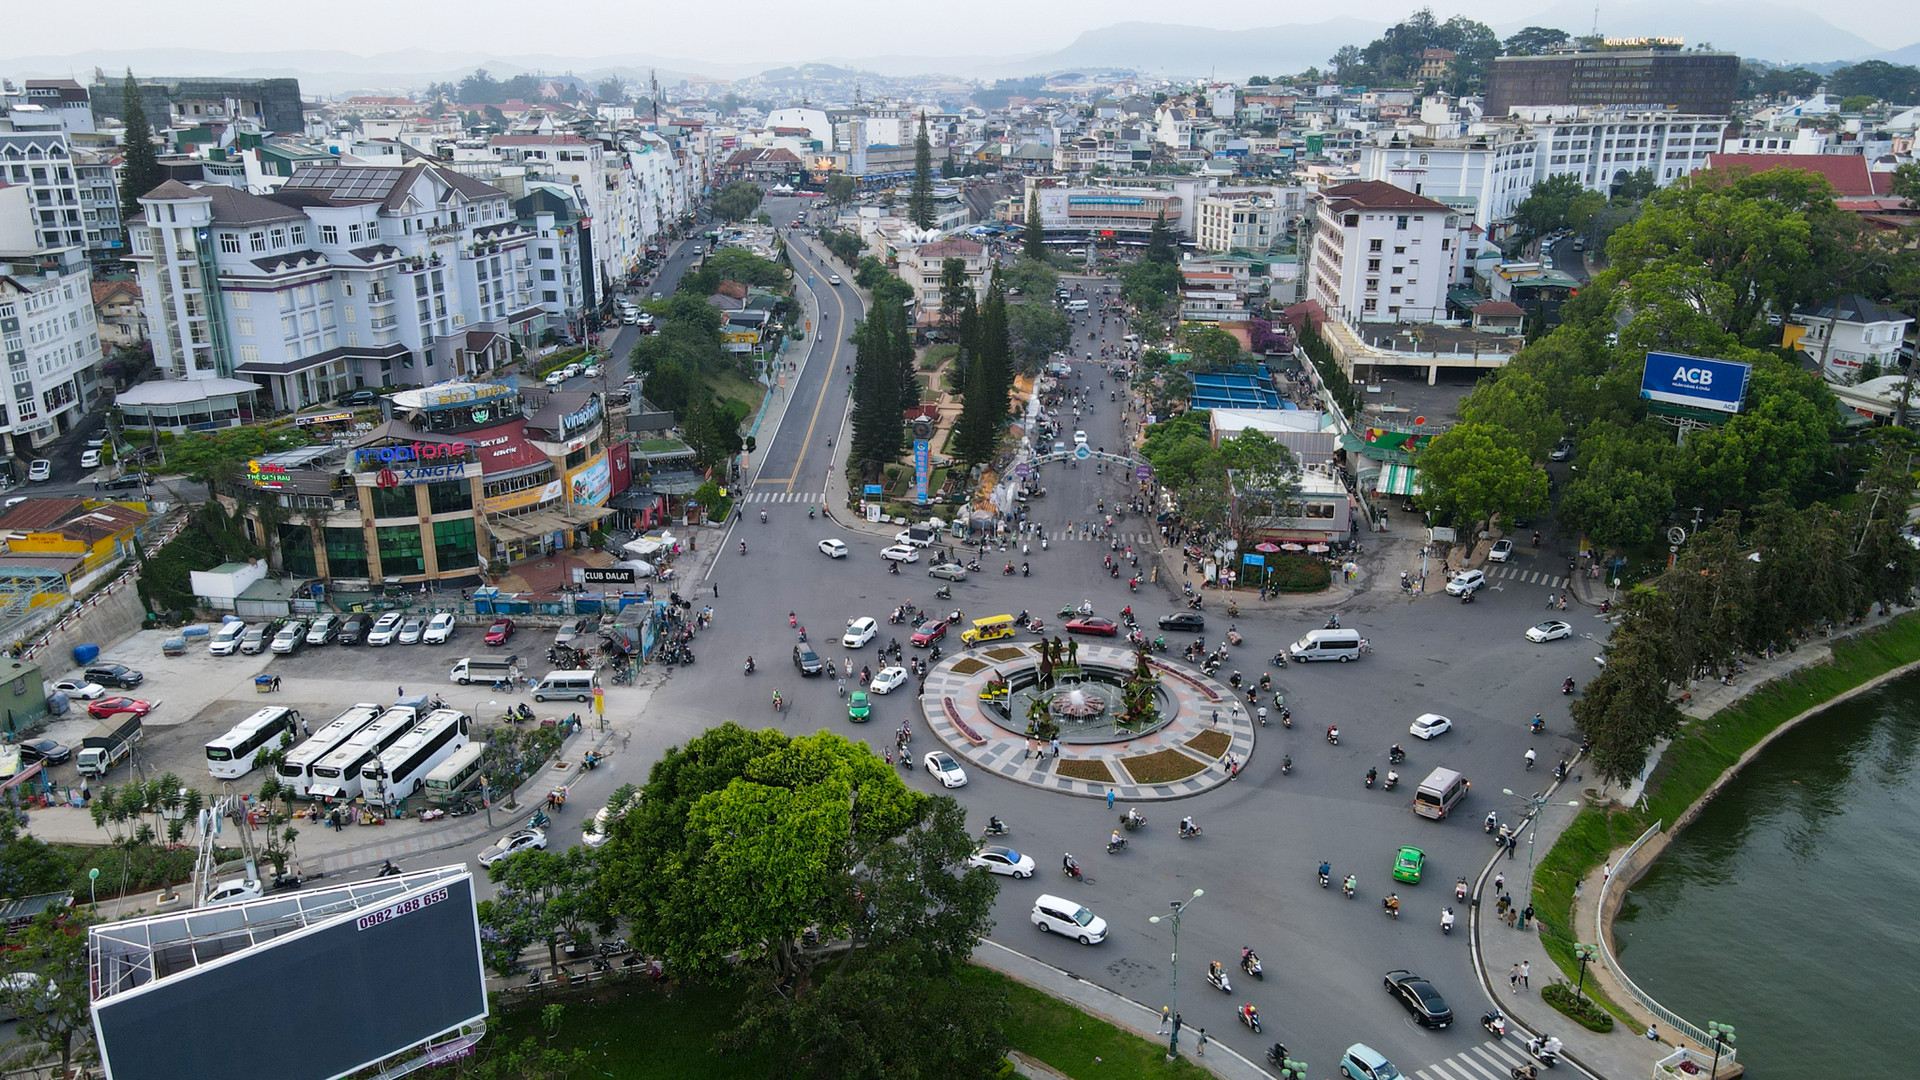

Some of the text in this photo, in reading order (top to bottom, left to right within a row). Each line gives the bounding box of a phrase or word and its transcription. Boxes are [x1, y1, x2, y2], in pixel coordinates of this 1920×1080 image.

[1672, 366, 1713, 385] ACB
[1722, 403, 1736, 411] ACB
[355, 440, 466, 463] mobifone
[403, 464, 465, 480] XINGFA
[585, 571, 629, 580] CLUB DALAT
[359, 888, 448, 930] 0982 488 655
